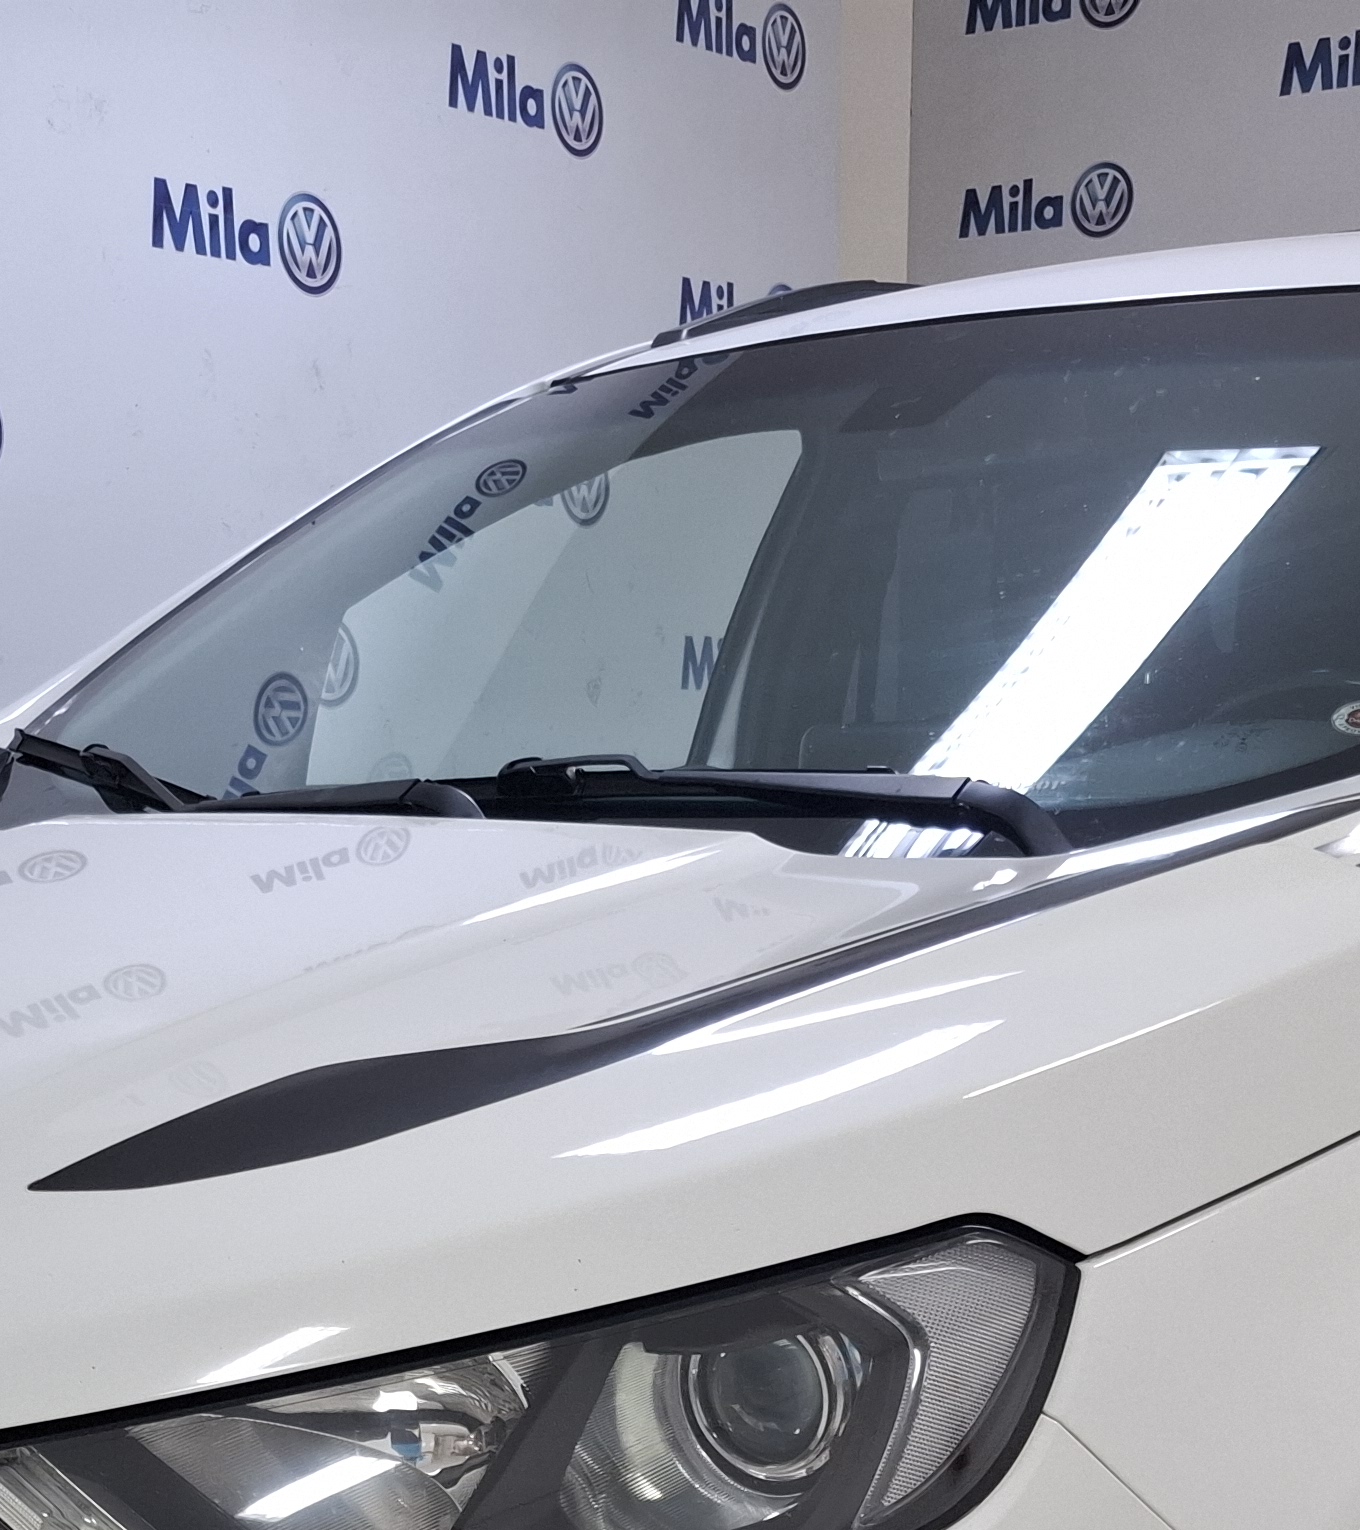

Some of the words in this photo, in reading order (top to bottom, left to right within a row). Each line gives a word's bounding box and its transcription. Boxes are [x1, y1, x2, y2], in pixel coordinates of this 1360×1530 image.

[676, 0, 756, 64] Mila
[449, 43, 544, 129] Mila
[152, 177, 270, 266] Mila
[959, 178, 1063, 238] Mila
[679, 277, 734, 326] Mil
